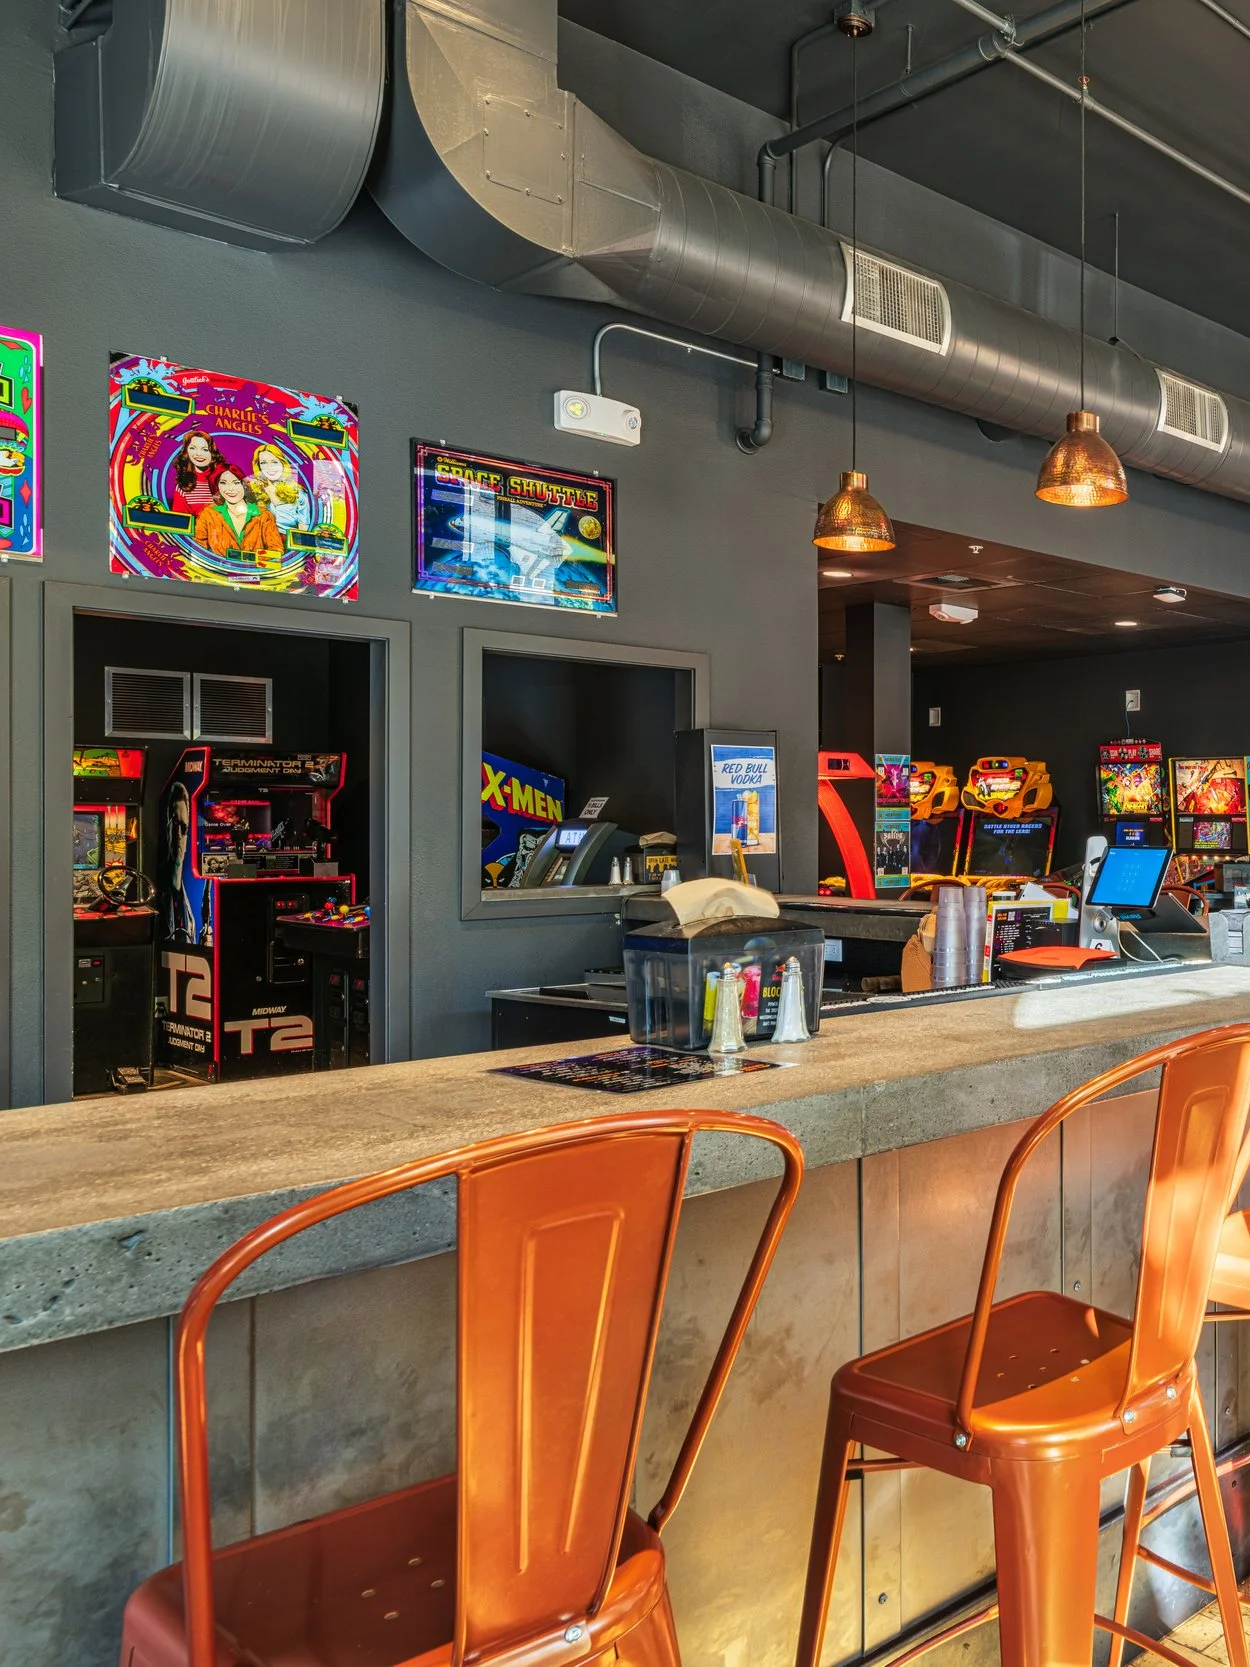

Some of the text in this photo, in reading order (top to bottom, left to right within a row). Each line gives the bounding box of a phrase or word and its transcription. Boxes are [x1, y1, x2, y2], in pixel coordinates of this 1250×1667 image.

[205, 404, 269, 425] CHARLIE'S
[215, 418, 263, 435] ANGELS
[436, 463, 598, 511] SPACE SHUTTLE
[213, 758, 301, 768] TERMINATOR
[222, 766, 280, 774] JUDGMENT
[721, 763, 768, 774] RED BULL
[730, 774, 763, 784] VODKA
[481, 762, 563, 825] X-MEN
[162, 951, 212, 1021] T2
[252, 1006, 287, 1016] MIDWAY
[162, 1020, 212, 1043] TERMINATOR 2
[224, 1015, 313, 1055] T2
[168, 1036, 206, 1054] JUDGMENT DAY
